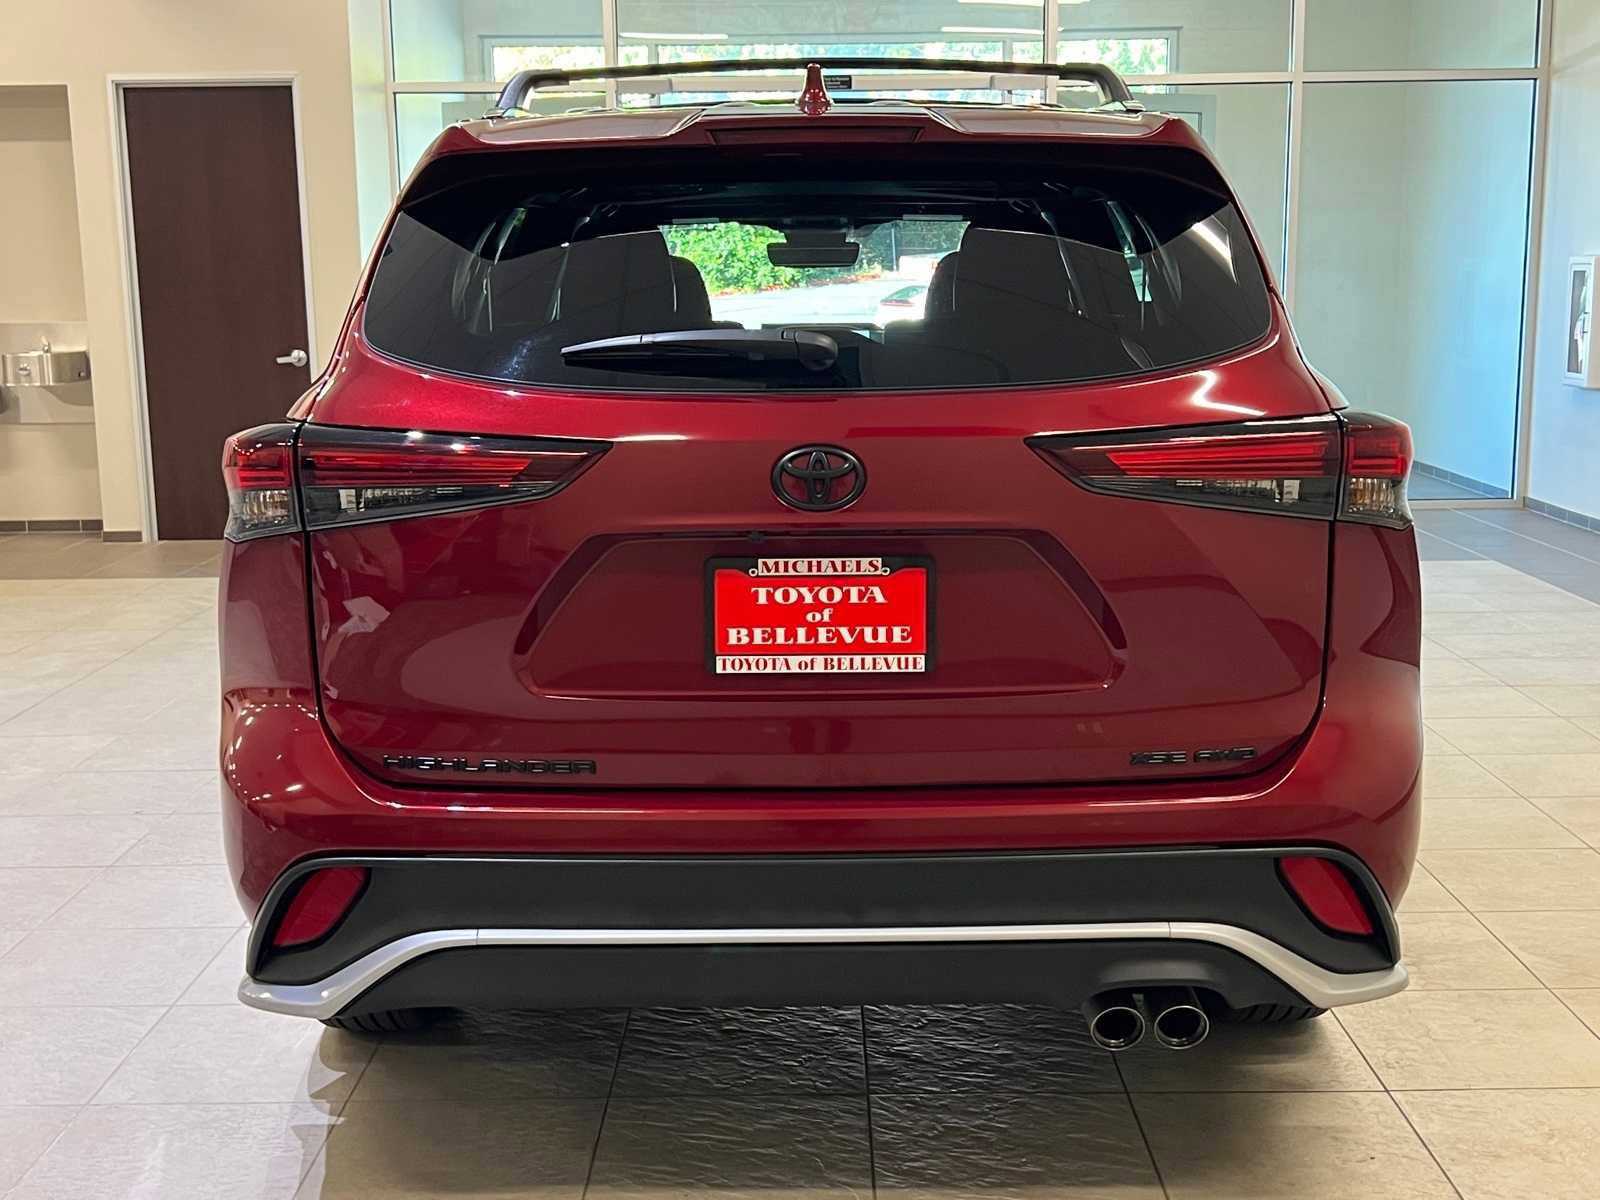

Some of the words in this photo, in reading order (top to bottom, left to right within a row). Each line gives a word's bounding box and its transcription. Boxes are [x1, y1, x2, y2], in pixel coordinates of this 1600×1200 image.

[760, 559, 881, 574] MICHAELS
[751, 586, 887, 604] TOYOTA
[806, 608, 833, 623] of
[726, 625, 913, 645] BELLEVUE
[718, 657, 791, 672] TOYOTA
[798, 656, 818, 671] of
[823, 656, 923, 671] BELLEVUE
[383, 754, 597, 775] HIGHLANDER
[1130, 751, 1187, 765] XSE
[1194, 747, 1255, 763] AWD
